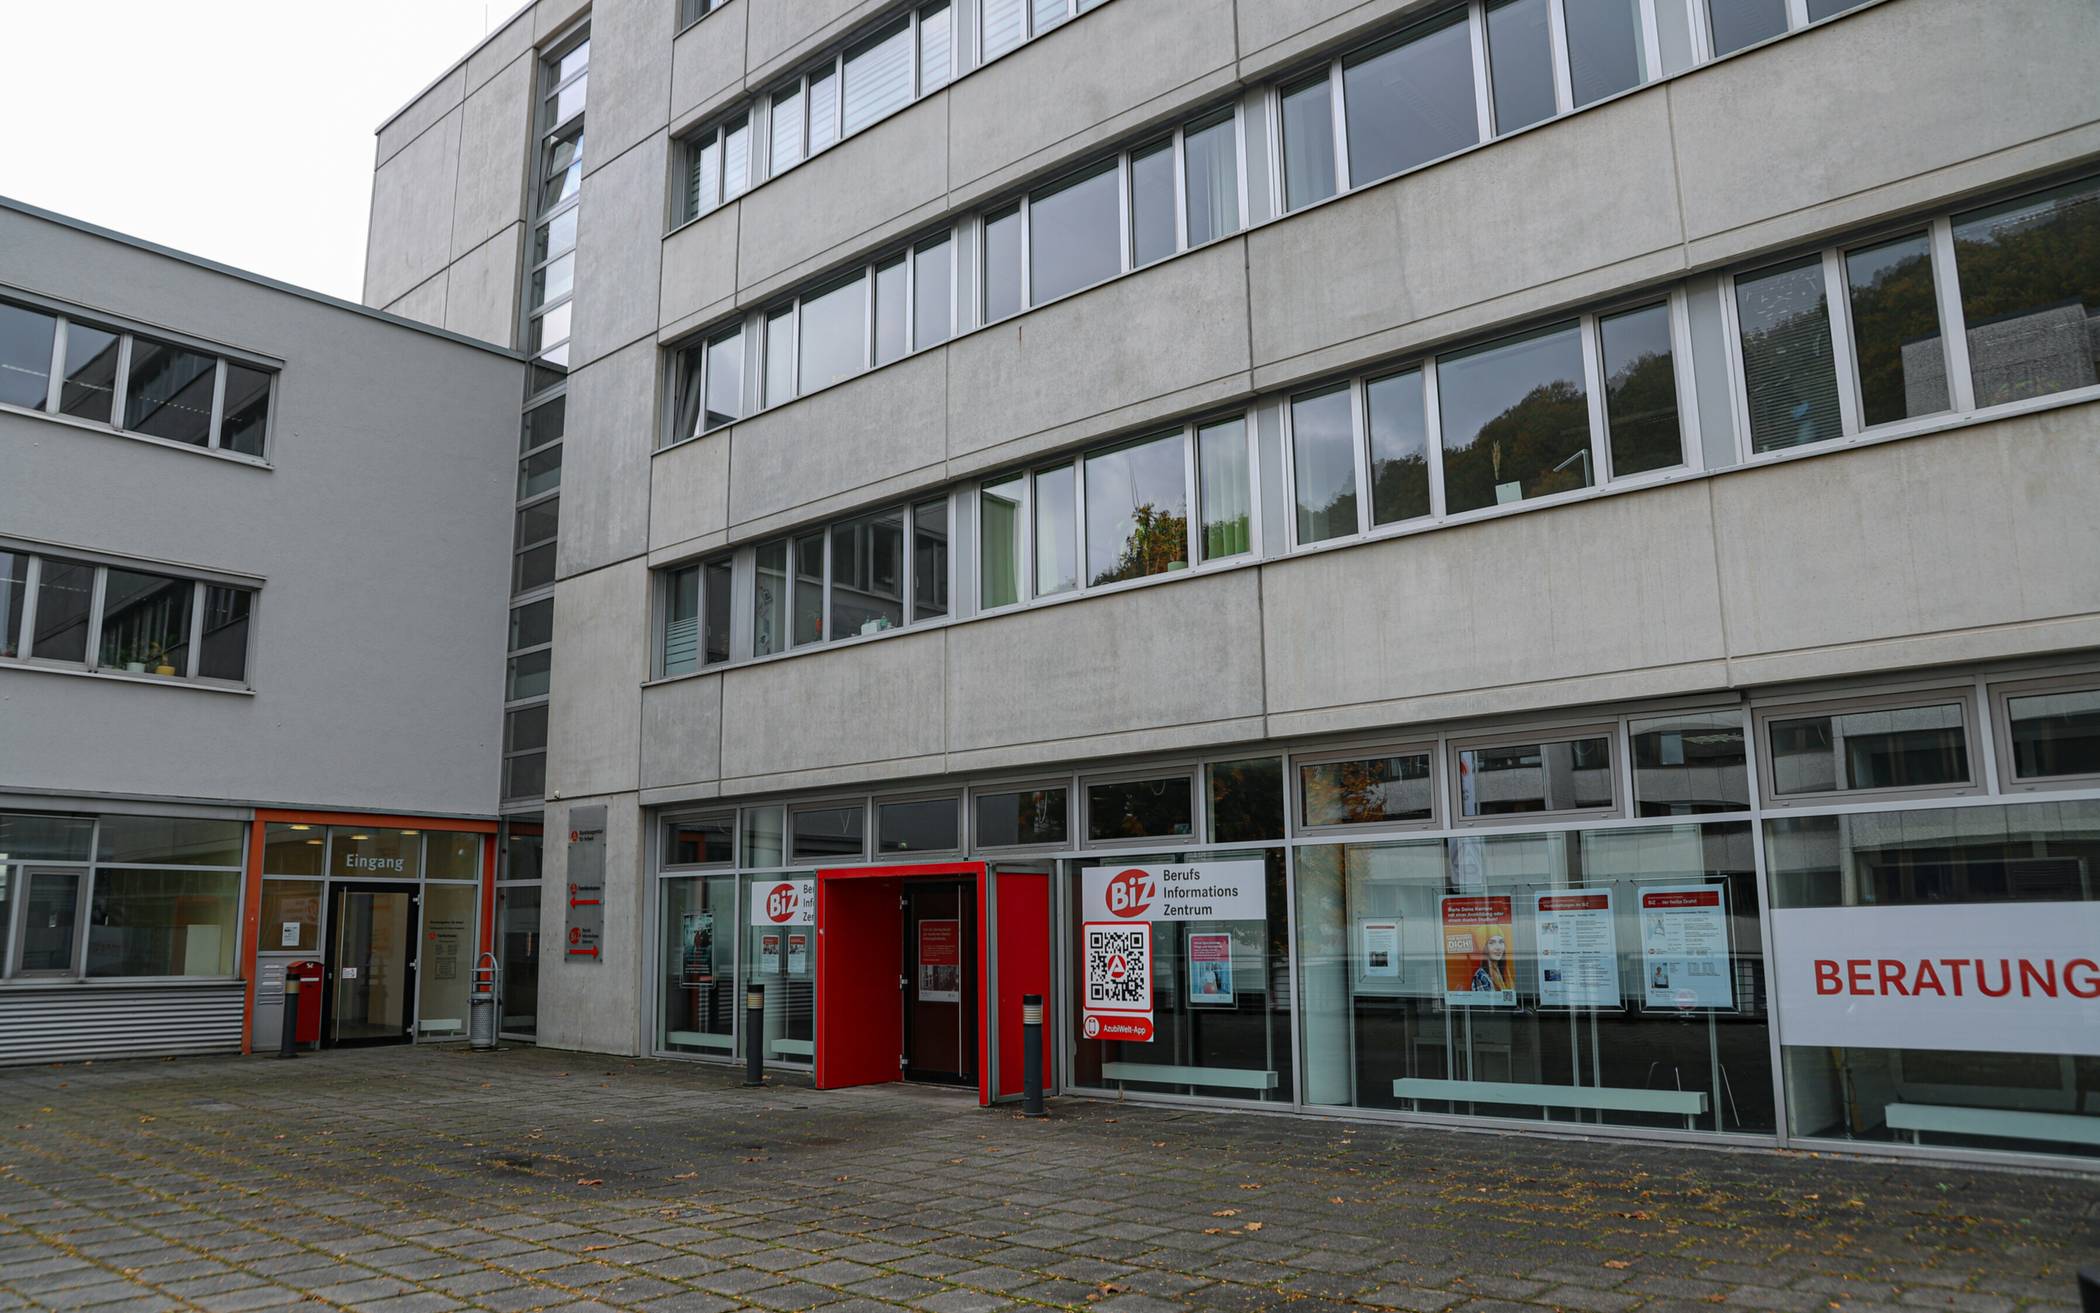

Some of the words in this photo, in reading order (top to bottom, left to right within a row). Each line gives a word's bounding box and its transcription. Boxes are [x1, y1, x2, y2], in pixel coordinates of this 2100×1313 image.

[346, 854, 405, 872] Eingang
[1163, 869, 1201, 881] Berufs
[1111, 877, 1155, 911] BiZ
[1163, 885, 1239, 899] Informations
[769, 890, 798, 917] BiZ
[1163, 904, 1213, 916] Zentrum
[1814, 958, 2100, 999] BERATUNG
[1103, 1024, 1146, 1036] AzubiWelt-App
